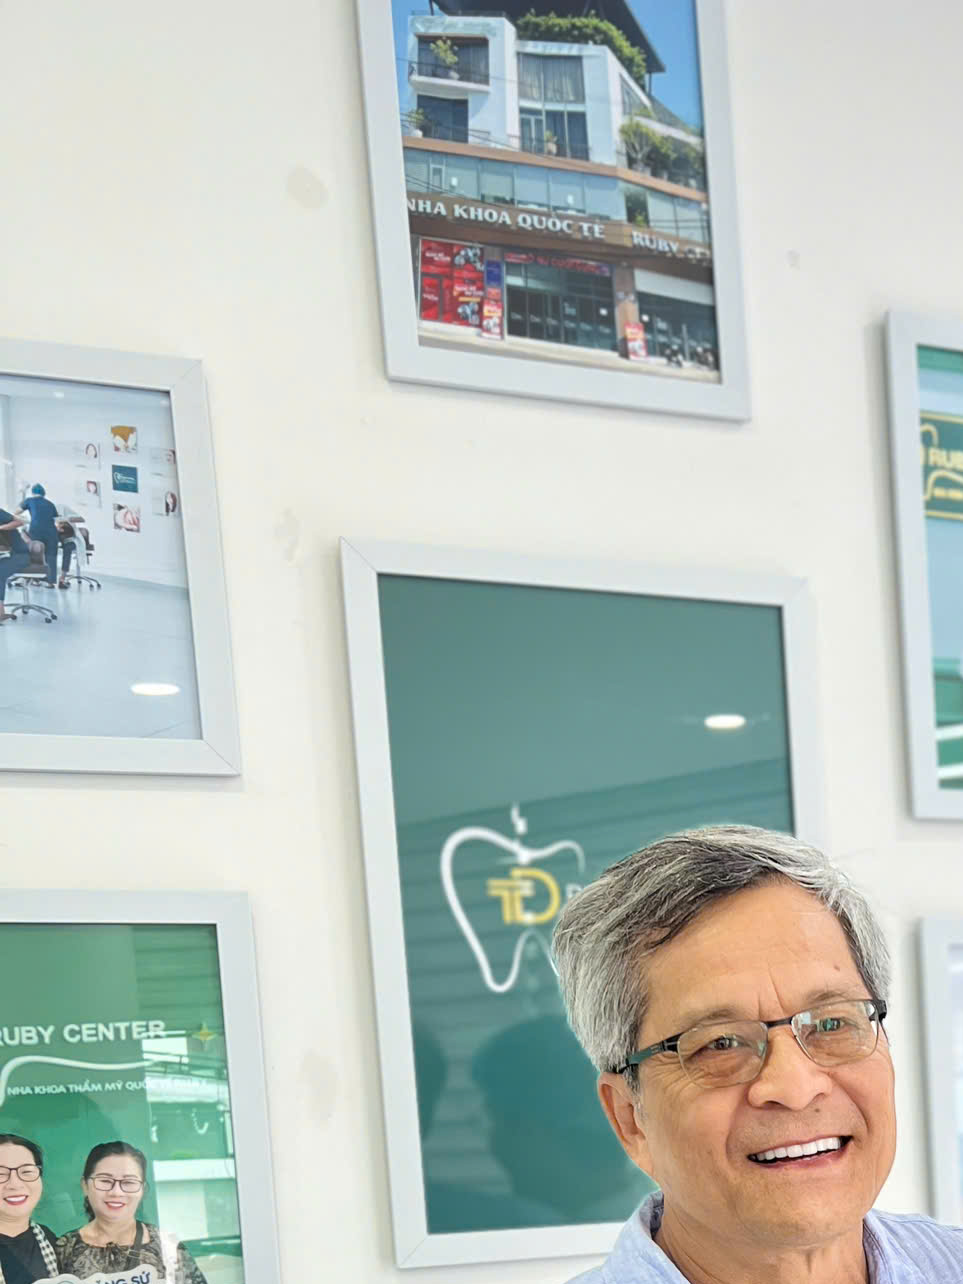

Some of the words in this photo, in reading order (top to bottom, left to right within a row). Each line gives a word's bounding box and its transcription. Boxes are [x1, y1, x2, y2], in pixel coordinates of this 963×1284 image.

[453, 204, 511, 225] KHOA
[632, 230, 679, 253] RUBY
[0, 1025, 55, 1047] UBY
[63, 1020, 165, 1043] CENTER
[7, 1086, 33, 1096] NHA
[34, 1084, 67, 1095] KHOA
[67, 1079, 103, 1093] THẨM
[104, 1079, 123, 1092] MỸ
